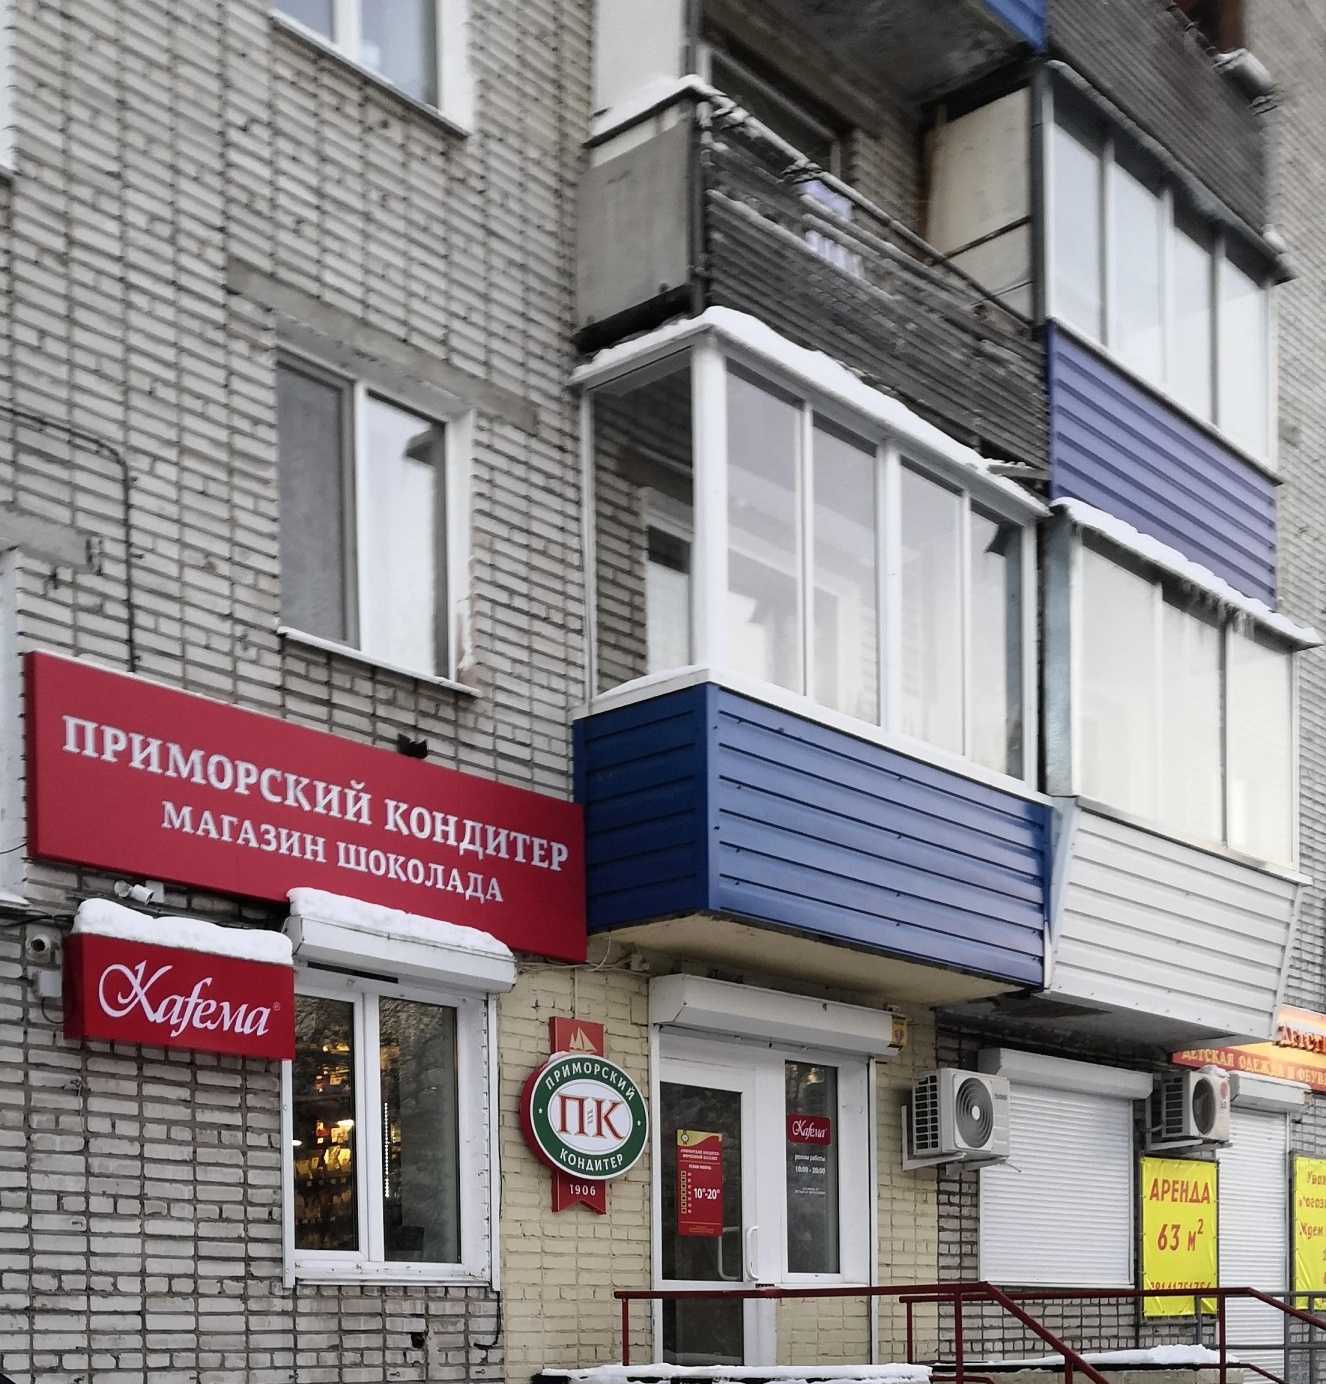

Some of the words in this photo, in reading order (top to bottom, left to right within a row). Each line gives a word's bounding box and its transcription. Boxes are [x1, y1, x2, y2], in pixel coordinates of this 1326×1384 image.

[62, 714, 372, 826] ПРИМОРСКИЙ
[384, 799, 569, 872] КОНДИТЕР
[161, 800, 327, 863] МАГАЗИН
[336, 841, 504, 904] ШОКОЛАДА
[545, 1061, 636, 1101] ПРИМОРСКИЙ
[559, 1148, 624, 1172] КОНДИТЕР
[569, 1184, 596, 1197] 1906
[1149, 1177, 1211, 1205] АРЕНДА
[1157, 1223, 1181, 1251] 63
